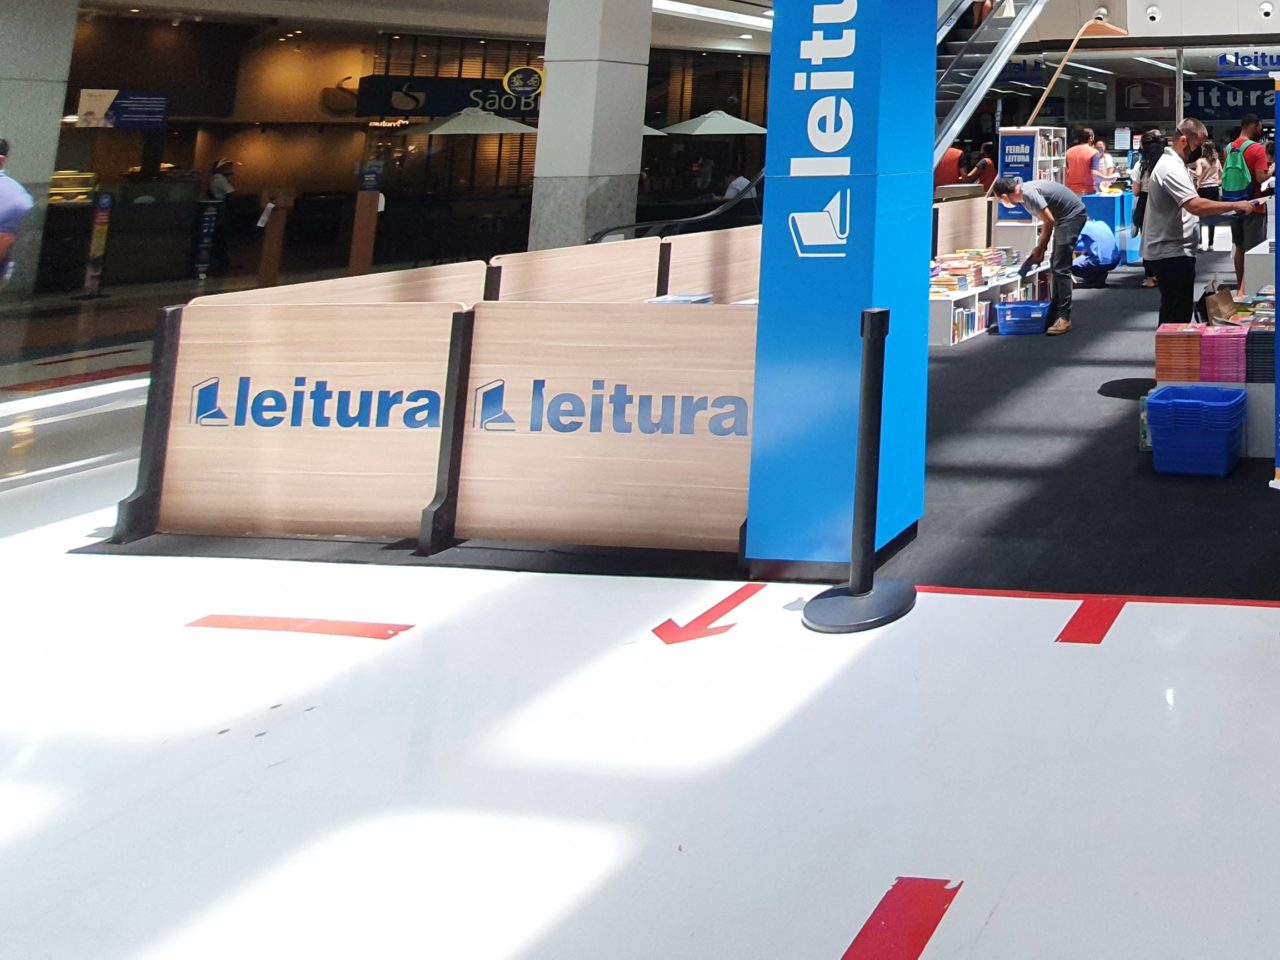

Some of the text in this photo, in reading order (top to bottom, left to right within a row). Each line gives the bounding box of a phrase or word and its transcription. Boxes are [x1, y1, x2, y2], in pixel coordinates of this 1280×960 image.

[469, 89, 540, 110] São B
[234, 376, 441, 429] leitura
[530, 379, 749, 437] leitura
